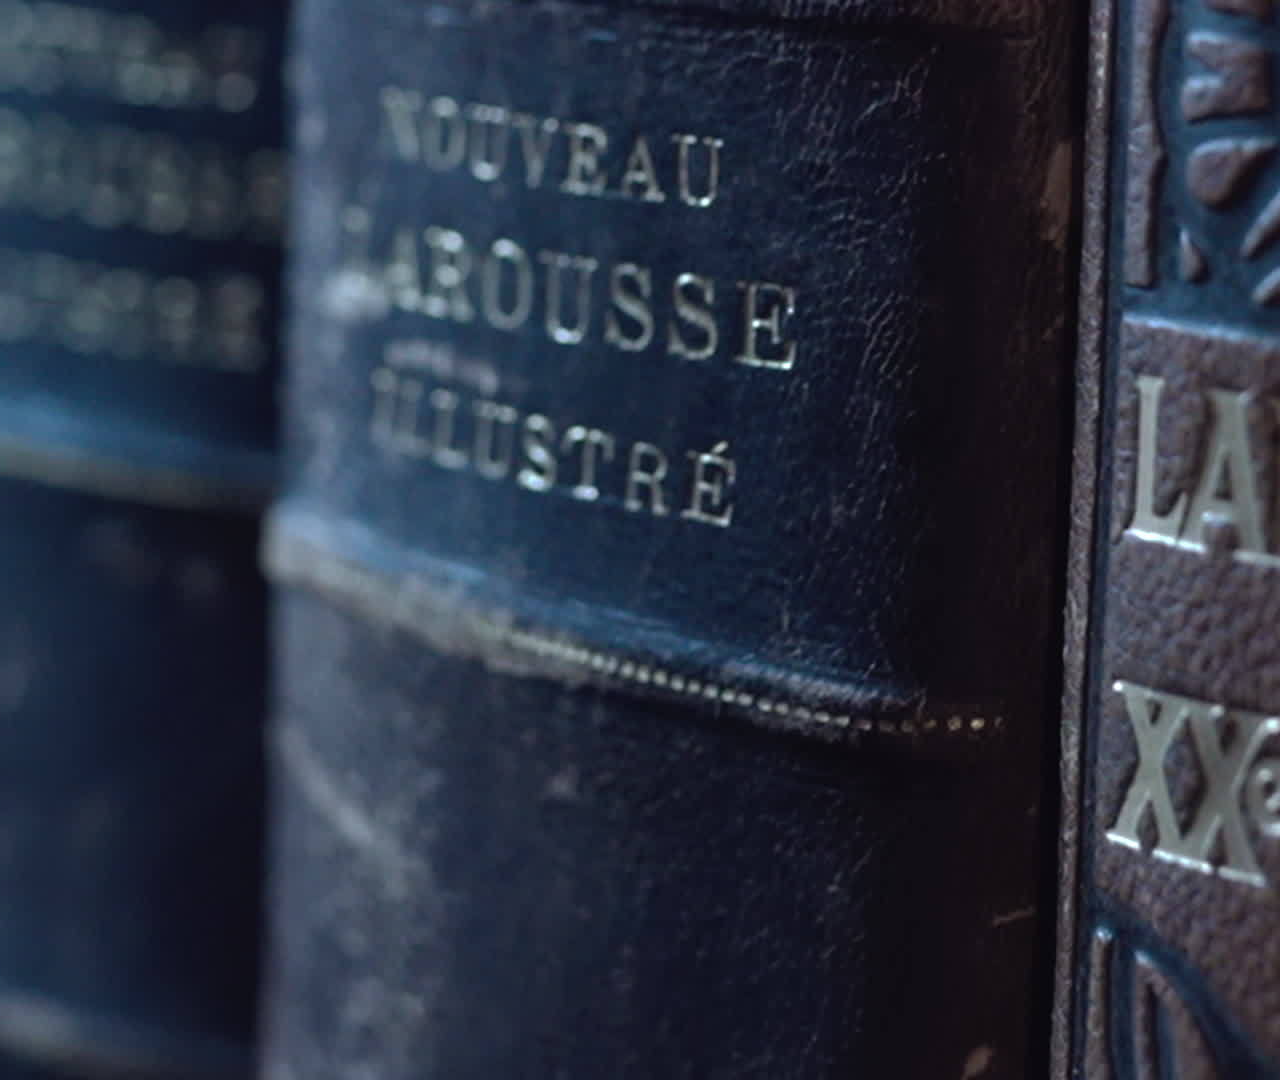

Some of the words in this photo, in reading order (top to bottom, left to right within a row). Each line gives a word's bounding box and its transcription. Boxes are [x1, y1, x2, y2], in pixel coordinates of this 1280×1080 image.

[380, 86, 724, 208] NOUVEAU
[327, 204, 797, 371] LAROUSSE
[370, 368, 737, 528] ILLUSTRÉ
